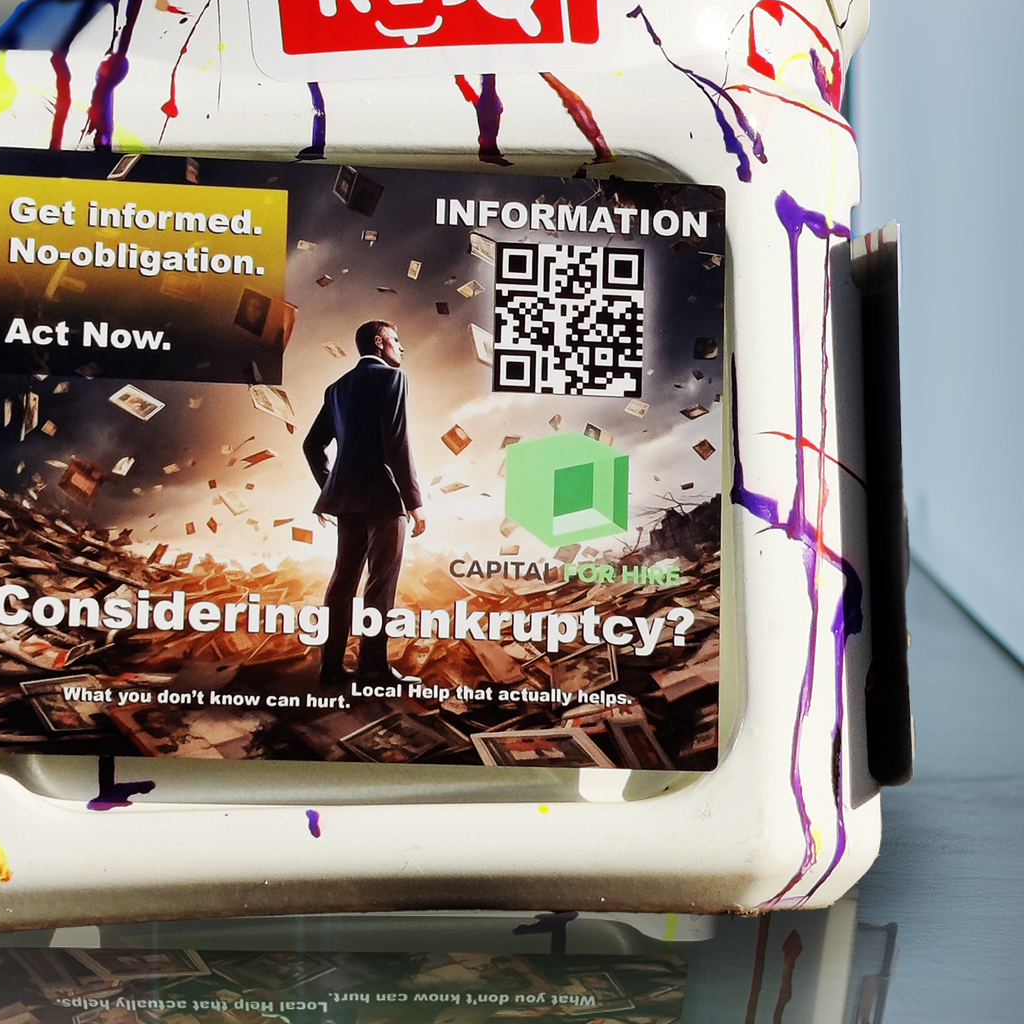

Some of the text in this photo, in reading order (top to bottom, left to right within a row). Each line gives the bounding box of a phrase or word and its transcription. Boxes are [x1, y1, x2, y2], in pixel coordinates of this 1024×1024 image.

[10, 196, 263, 235] Get informed.
[435, 198, 708, 238] INFORMATION
[8, 237, 266, 276] No-obligation.
[4, 318, 171, 350] Act Now.
[564, 562, 616, 584] FOR
[622, 564, 682, 587] HIRE
[351, 596, 695, 657] bankruptcy?
[64, 686, 112, 703] What
[118, 691, 152, 706] you
[210, 692, 261, 707] know
[266, 695, 301, 708] can
[306, 694, 351, 709] hurt.
[351, 682, 632, 707] Local Help that actually helps.
[115, 997, 187, 1011] actually
[192, 999, 228, 1011] that
[234, 999, 274, 1012] Help
[280, 1000, 328, 1013] Local
[377, 993, 408, 1002] can
[414, 992, 461, 1004] know
[515, 992, 546, 1004] you
[551, 994, 596, 1006] What
